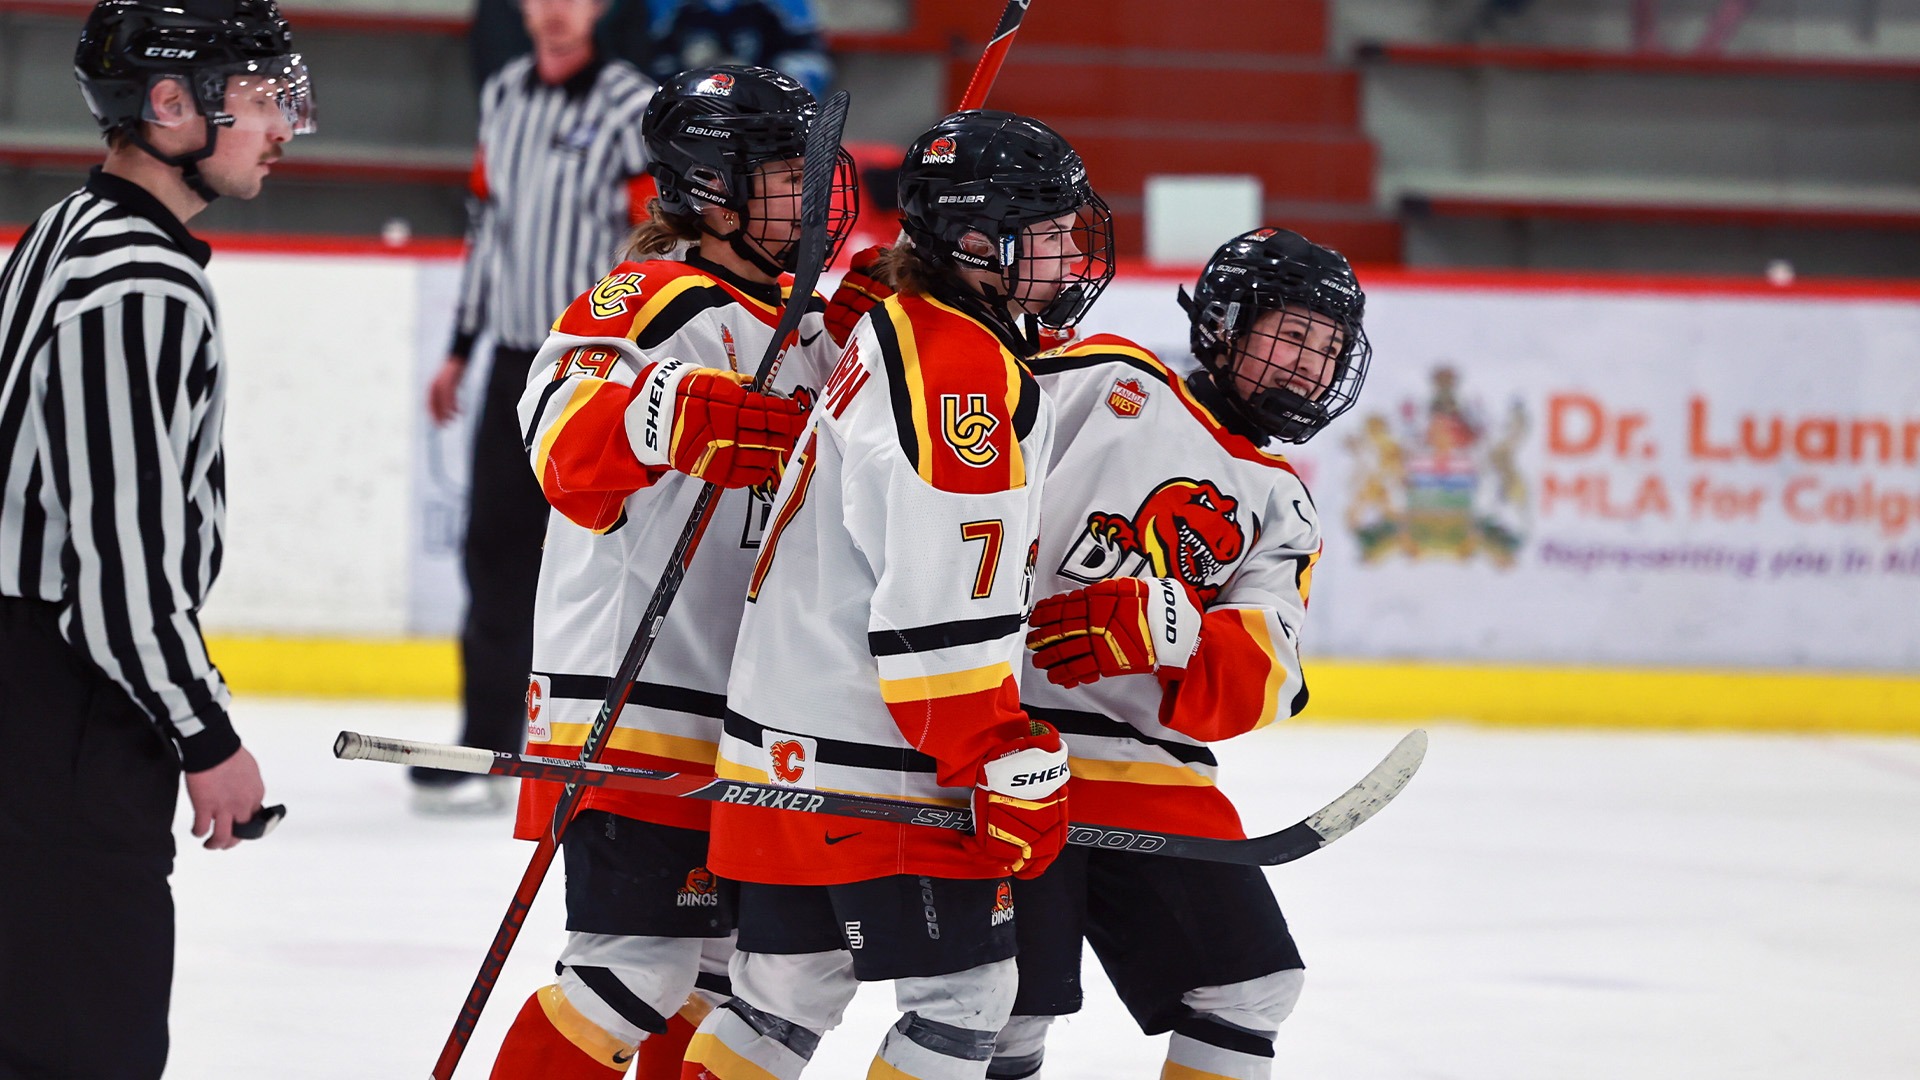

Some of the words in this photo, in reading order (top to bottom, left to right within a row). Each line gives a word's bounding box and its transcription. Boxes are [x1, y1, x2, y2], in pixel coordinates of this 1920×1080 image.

[144, 46, 197, 60] CCM
[685, 125, 731, 140] BAUER
[922, 153, 956, 165] DINOS
[690, 187, 726, 205] BAUER
[938, 194, 985, 205] BAUER
[951, 250, 989, 267] BAUER
[588, 271, 647, 321] UC
[552, 344, 621, 382] 19
[1110, 394, 1140, 415] WEST
[1114, 386, 1143, 405] CANADA
[940, 394, 1000, 468] UC
[1547, 393, 1656, 462] Dr.
[1539, 472, 1673, 522] MLA
[1690, 472, 1764, 520] for
[1782, 474, 1920, 537] Calg
[960, 518, 1004, 600] 7
[1159, 579, 1177, 645] WOOD
[565, 700, 614, 798] RKKER
[542, 756, 587, 770] ANDERSON
[720, 784, 824, 813] REKKER
[676, 892, 718, 906] DINOS
[991, 906, 1015, 927] DINOS
